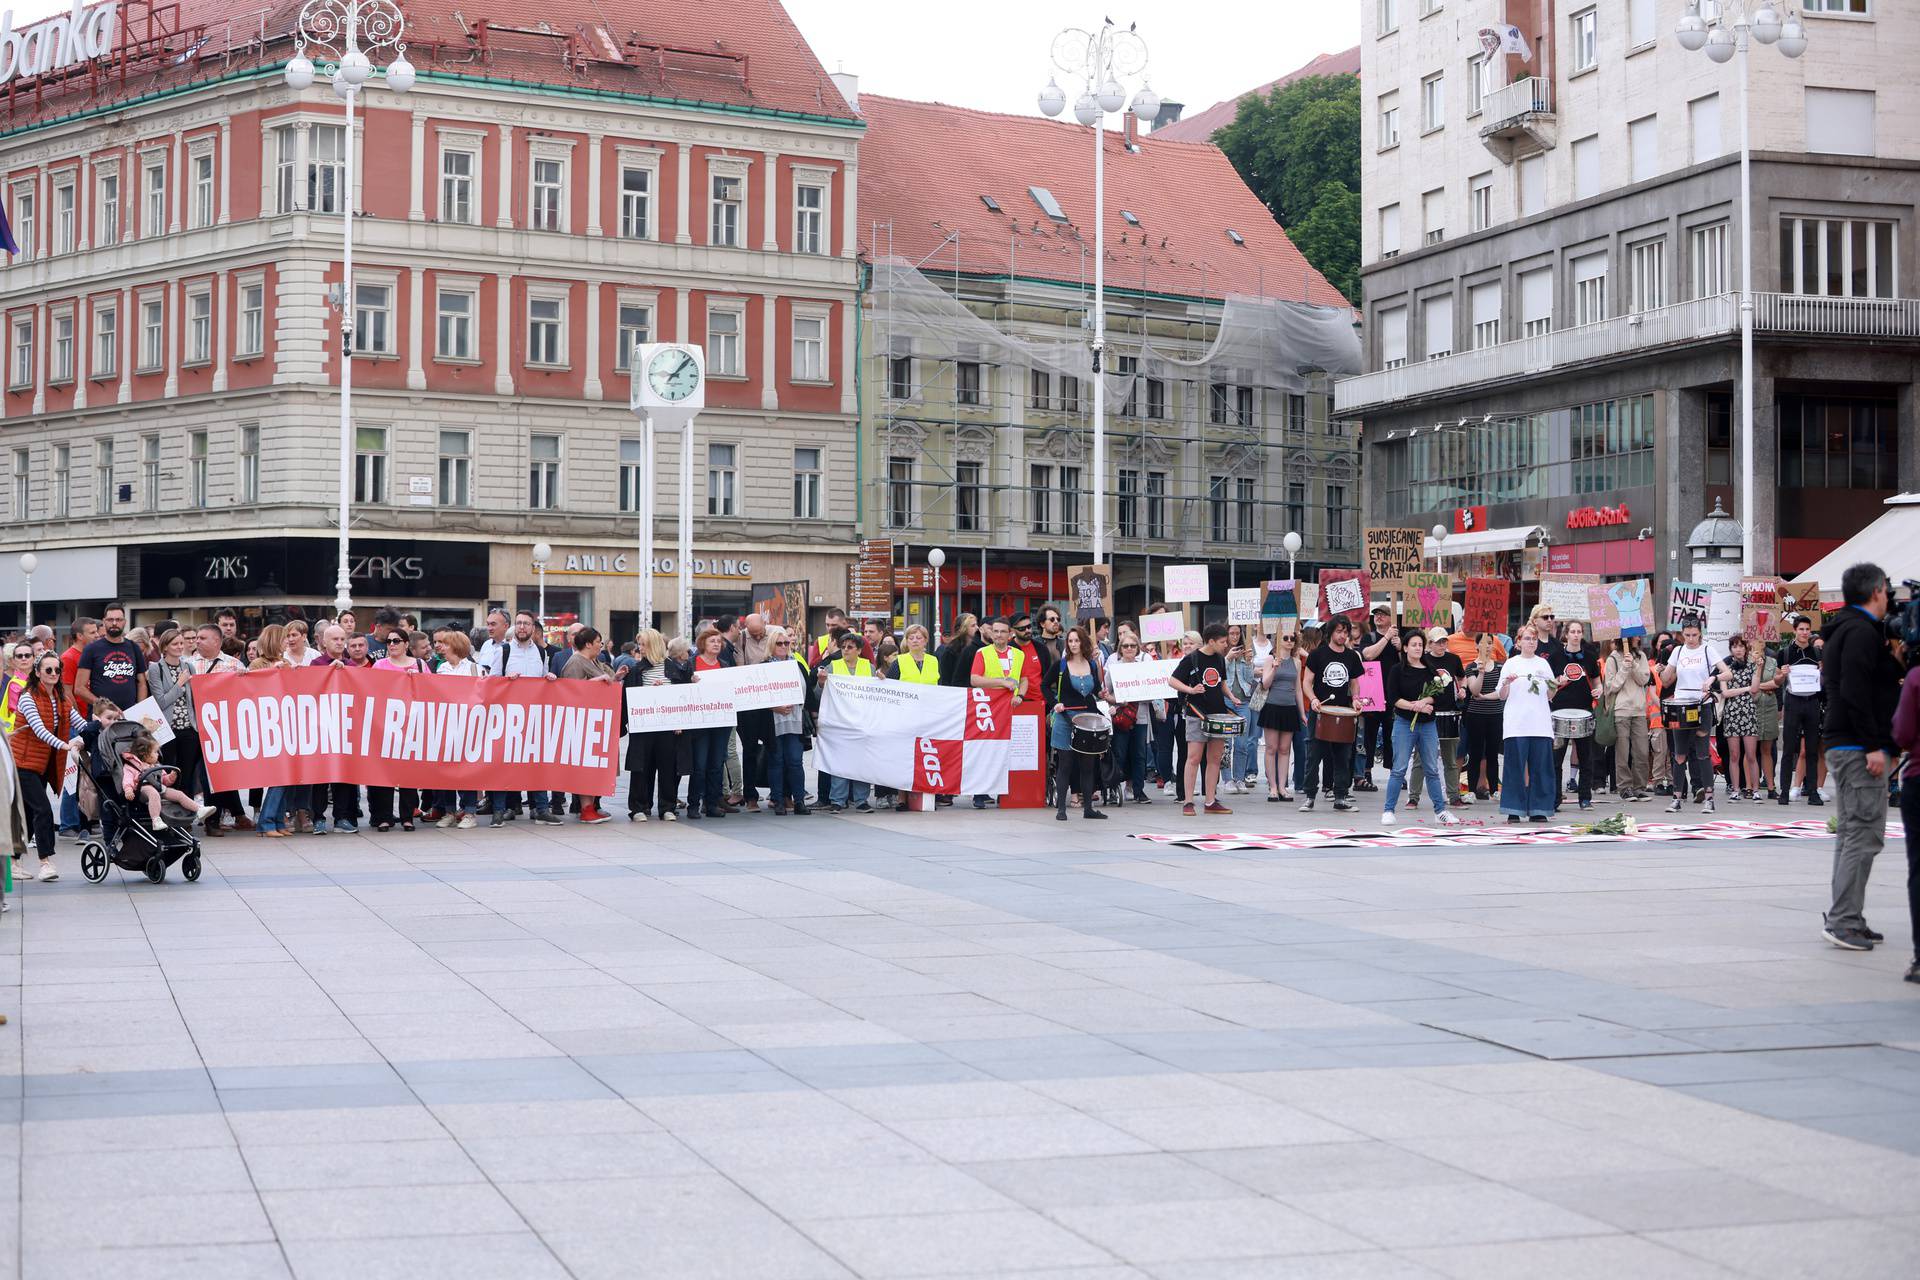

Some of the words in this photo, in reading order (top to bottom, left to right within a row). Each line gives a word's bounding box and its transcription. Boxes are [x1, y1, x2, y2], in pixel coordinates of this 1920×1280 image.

[0, 0, 117, 84] banka
[1368, 529, 1423, 548] SUOSJEĆANJE
[565, 553, 627, 572] ANIĆ
[652, 556, 751, 576] HODING
[1369, 547, 1421, 563] EMPATIJA
[204, 556, 248, 579] ZAKS
[351, 556, 424, 580] ZAKS
[1673, 586, 1707, 608] NIJE
[1405, 608, 1449, 625] PRAVA!
[835, 682, 919, 701] SOCIJALDEMOKRATSKA
[865, 694, 901, 706] HRVATSKE
[631, 706, 655, 716] Zagreb
[971, 687, 995, 732] SDP
[200, 693, 355, 764] SLOBODNE
[361, 696, 374, 757] I
[380, 701, 613, 769] RAVNOPRAVNE!
[919, 737, 944, 788] SDP
